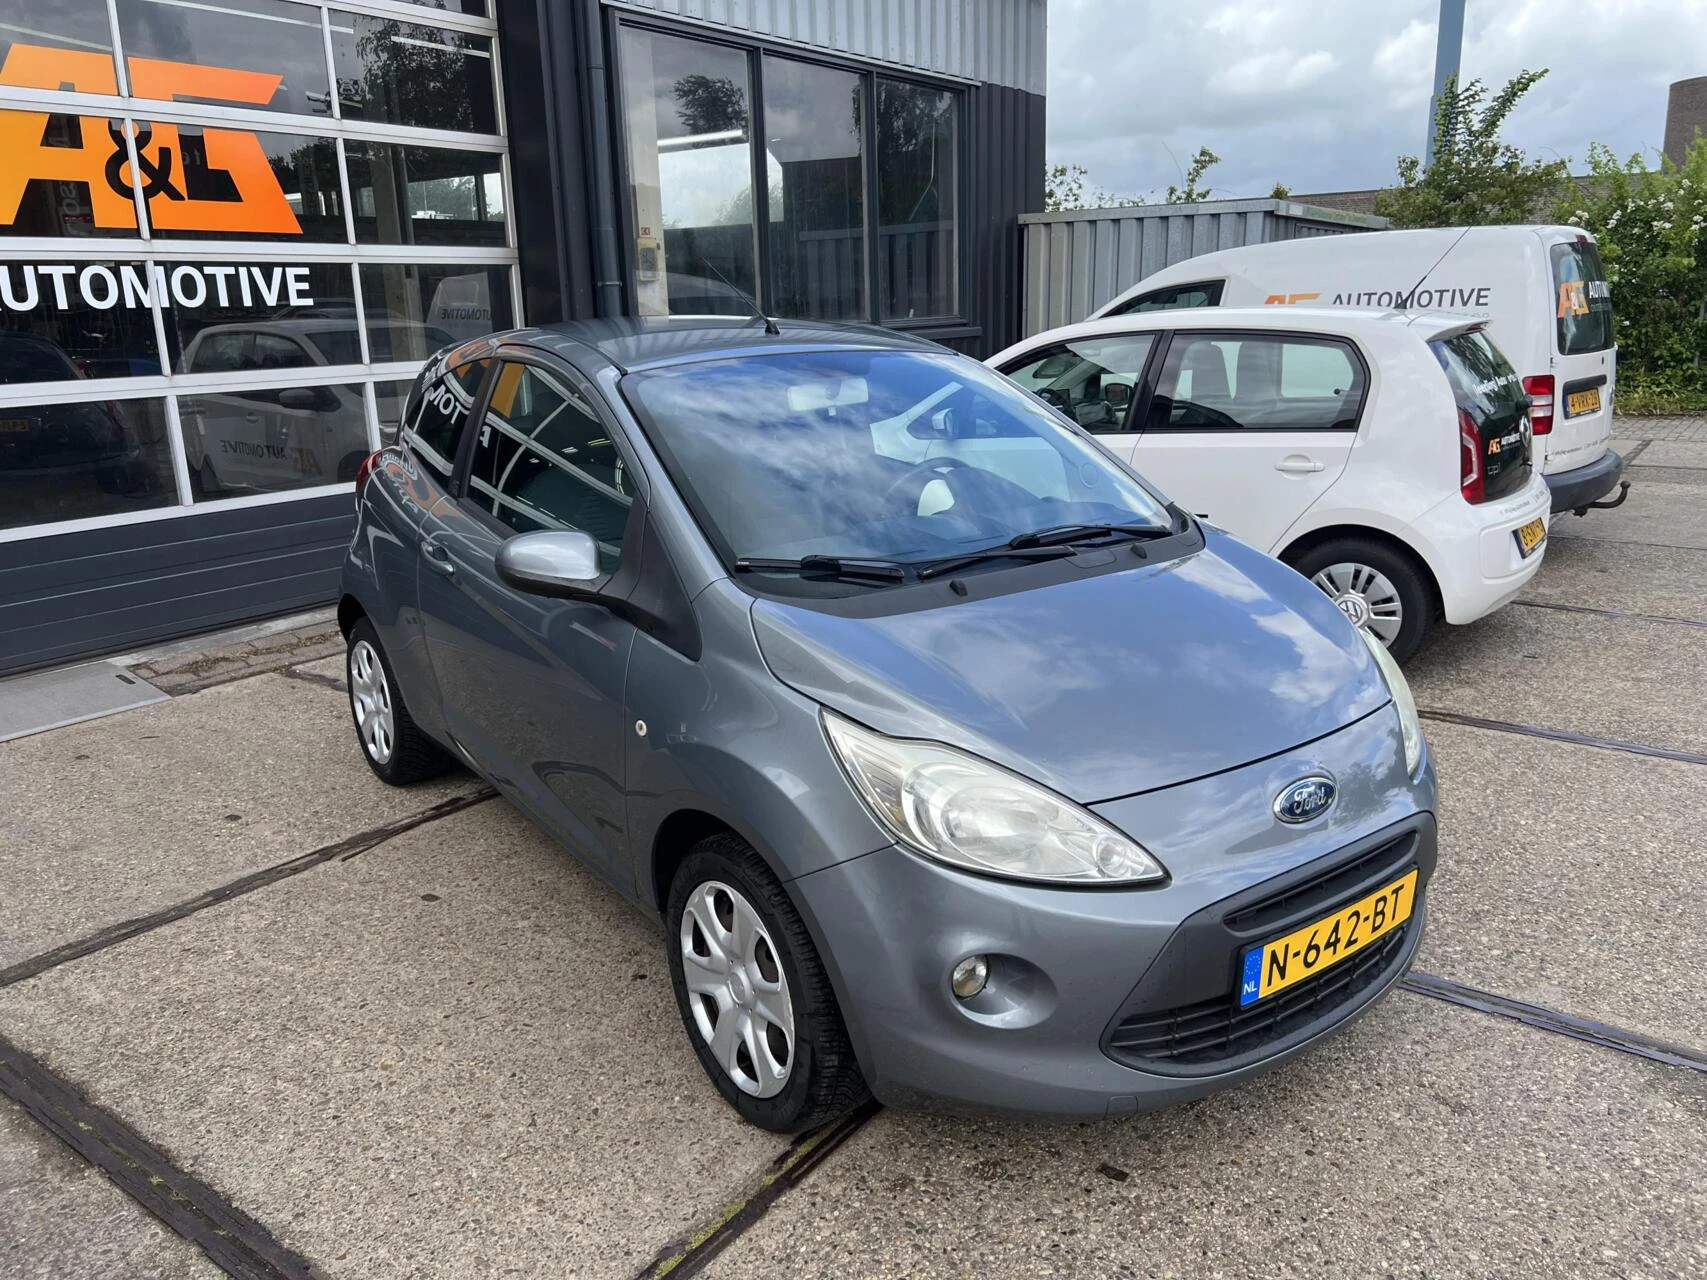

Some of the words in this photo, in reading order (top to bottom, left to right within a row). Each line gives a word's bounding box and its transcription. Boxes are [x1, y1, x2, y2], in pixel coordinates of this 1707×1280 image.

[0, 264, 314, 311] UTOMOTIVE
[1294, 785, 1327, 814] Ford
[1266, 884, 1404, 988] N-642-BT
[1243, 982, 1258, 994] NL
